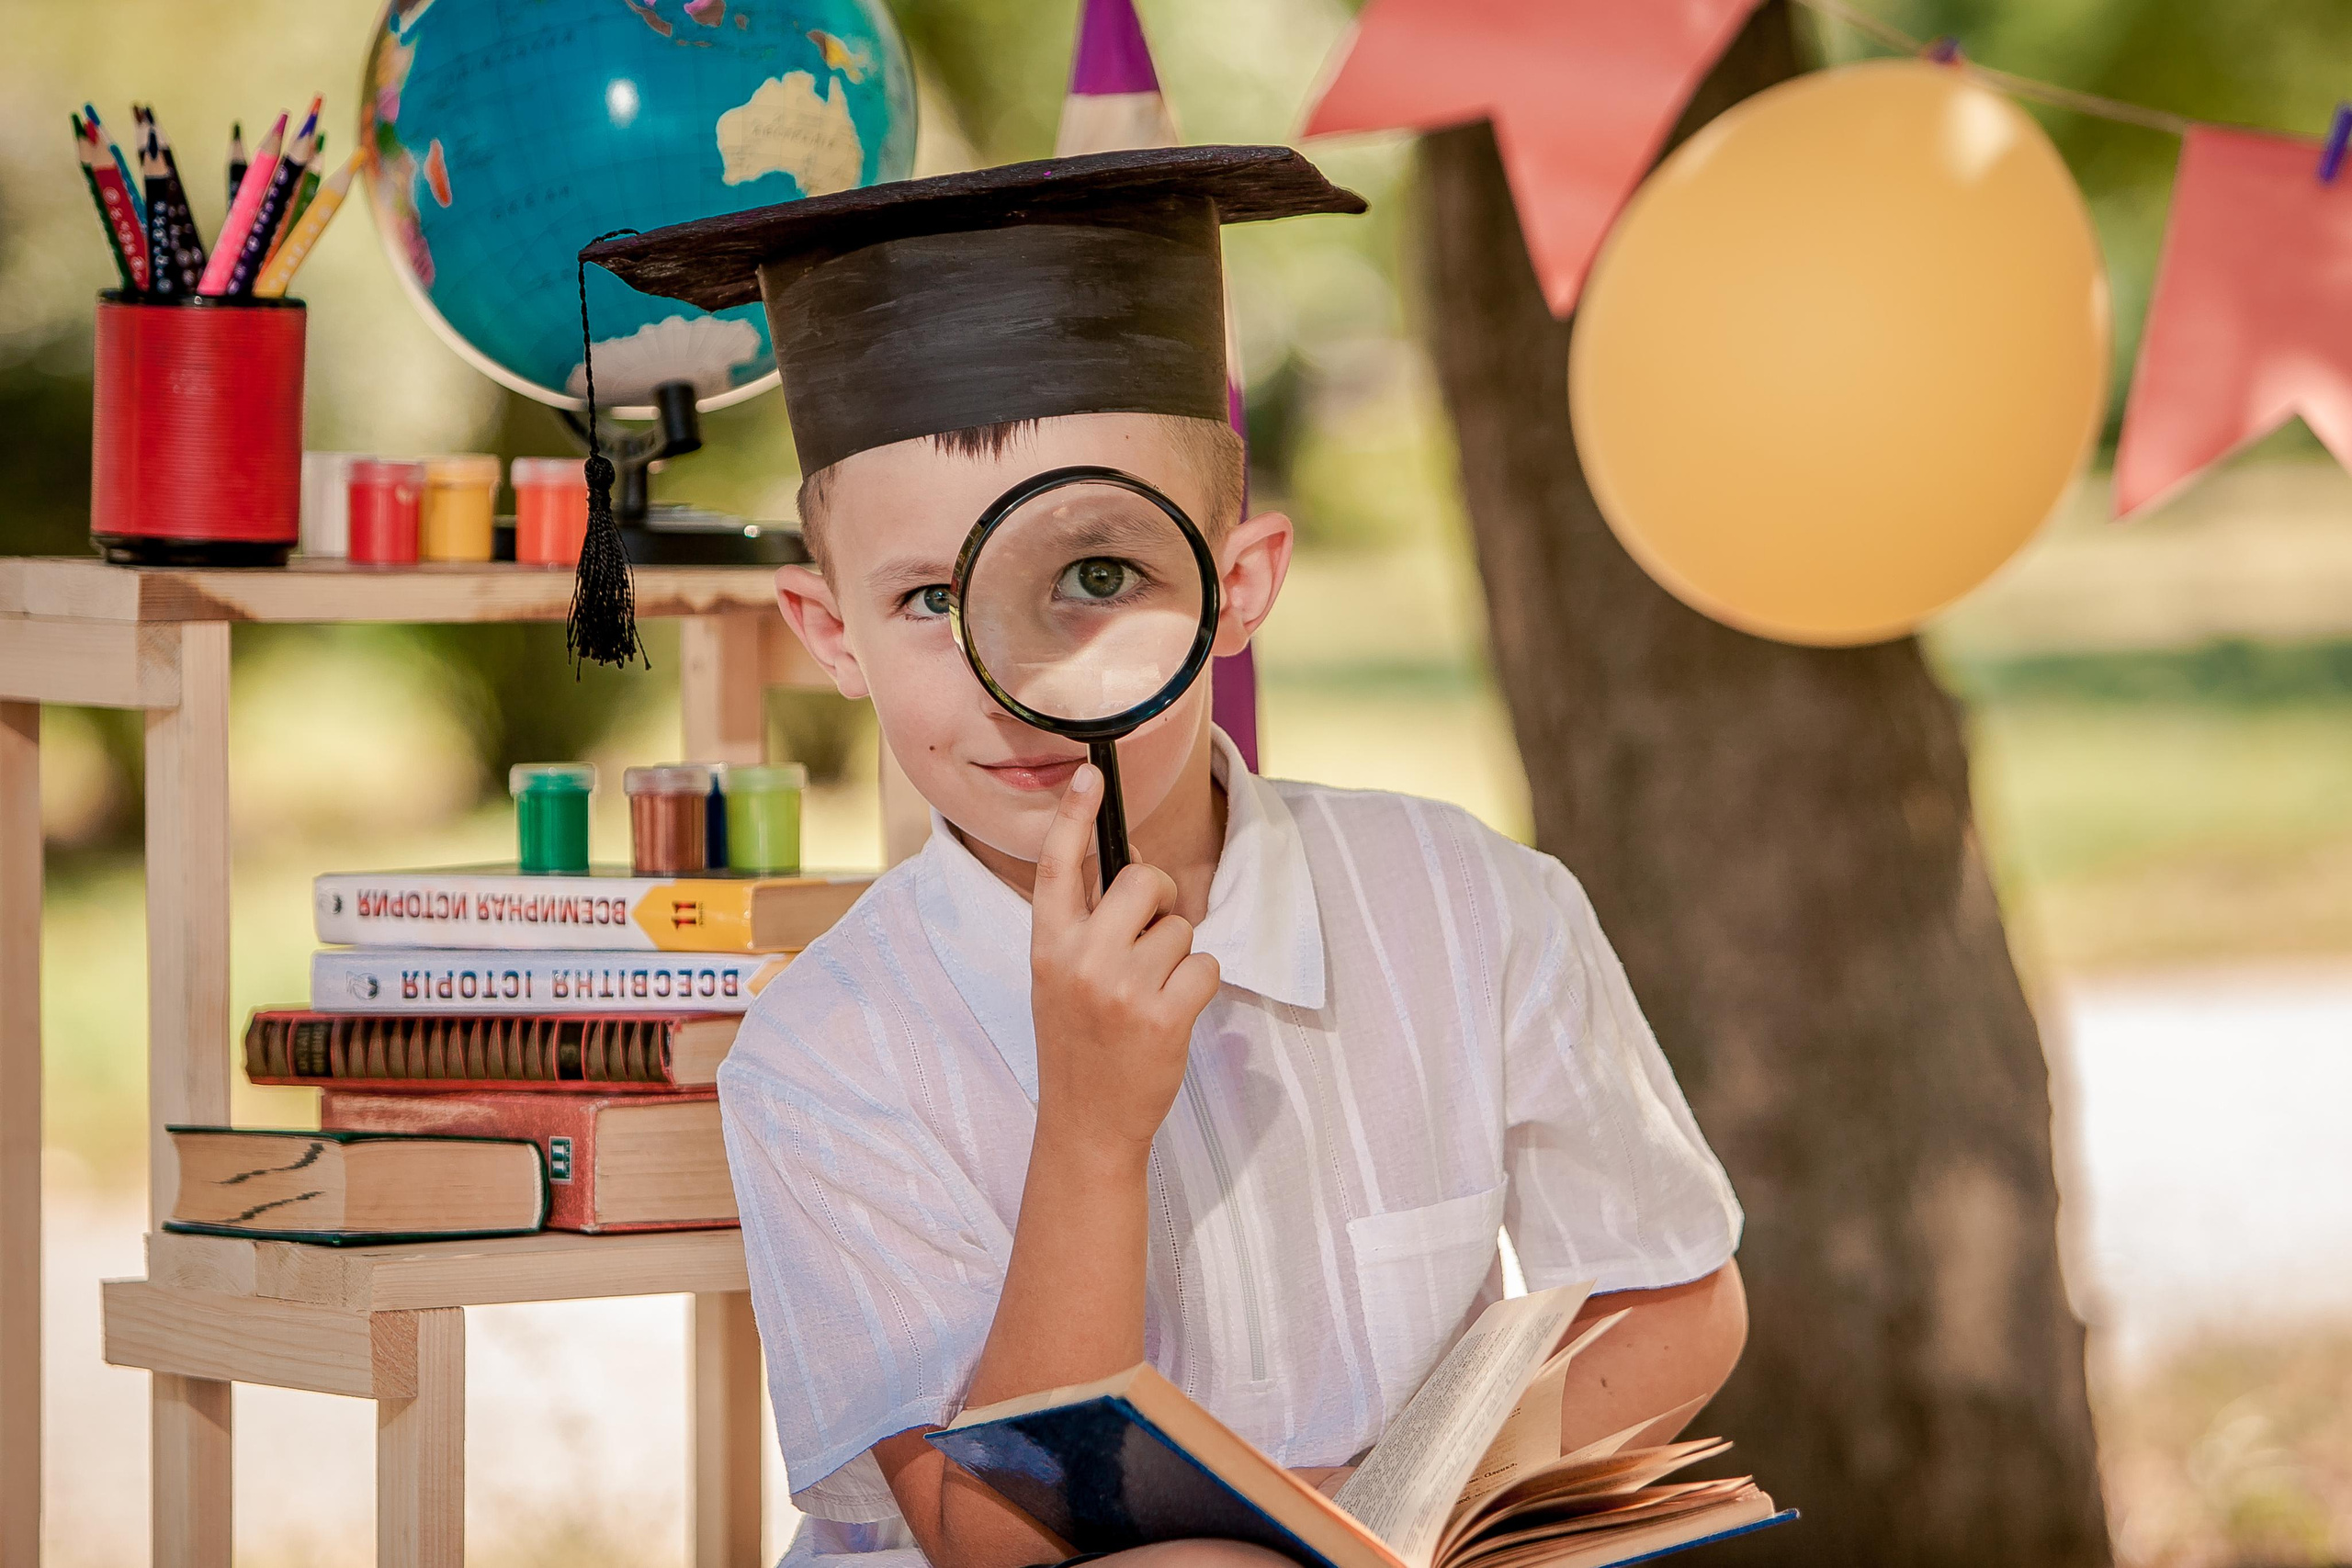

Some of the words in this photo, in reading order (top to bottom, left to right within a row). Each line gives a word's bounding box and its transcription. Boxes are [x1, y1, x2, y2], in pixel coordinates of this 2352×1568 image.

[356, 888, 468, 919] ИСТОРИЯ
[476, 892, 627, 926] ВСЕМИРНАЯ
[672, 900, 697, 931] 11
[401, 969, 532, 999] ІСТОРІЯ
[551, 969, 739, 998] ВСЕСВІТНЯ
